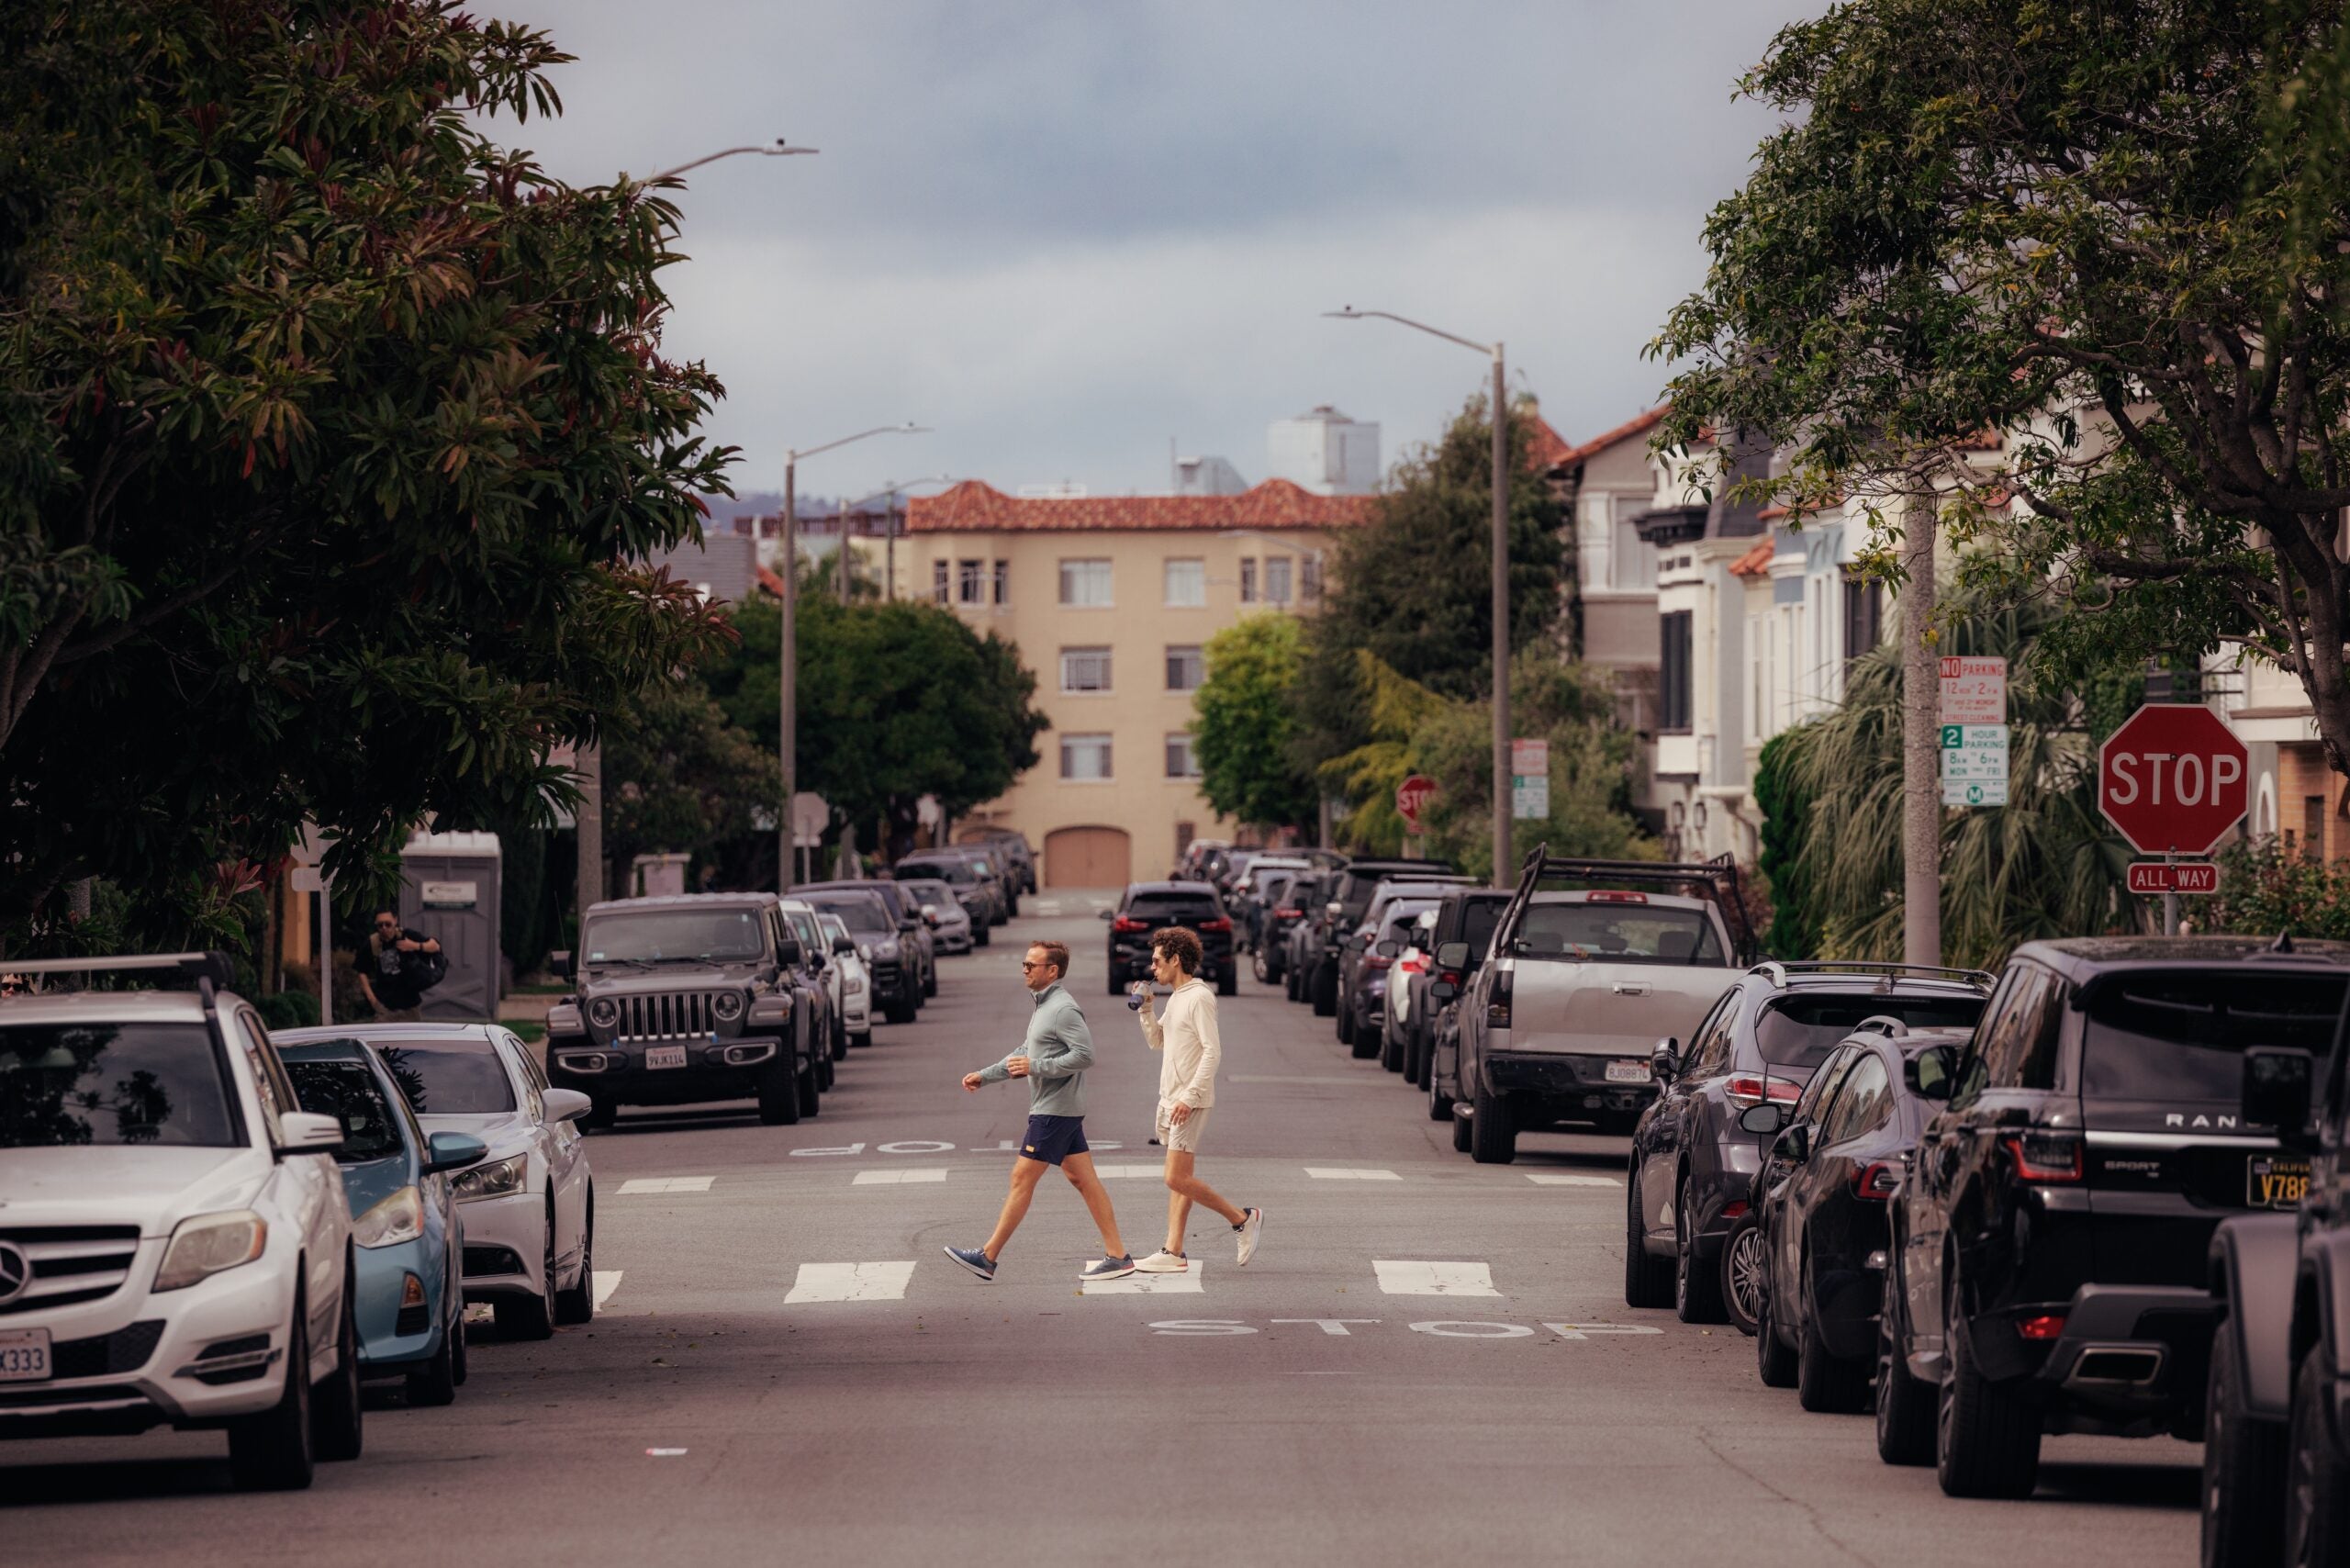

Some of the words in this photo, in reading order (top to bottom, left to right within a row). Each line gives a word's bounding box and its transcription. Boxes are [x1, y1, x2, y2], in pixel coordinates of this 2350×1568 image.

[1942, 659, 1960, 677] NO
[1963, 664, 2003, 676] PARKING
[1946, 729, 1959, 745] 2
[1971, 730, 1998, 739] HOUR
[1964, 740, 2005, 749] PARKING
[1950, 767, 1967, 776] MON
[1986, 767, 2000, 776] FRI
[2109, 752, 2242, 806] STOP
[2135, 870, 2168, 887] ALL
[2177, 870, 2210, 887] WAY
[2166, 1114, 2261, 1128] RAN
[2105, 1160, 2160, 1170] SPORT
[1147, 1319, 1665, 1339] STOP
